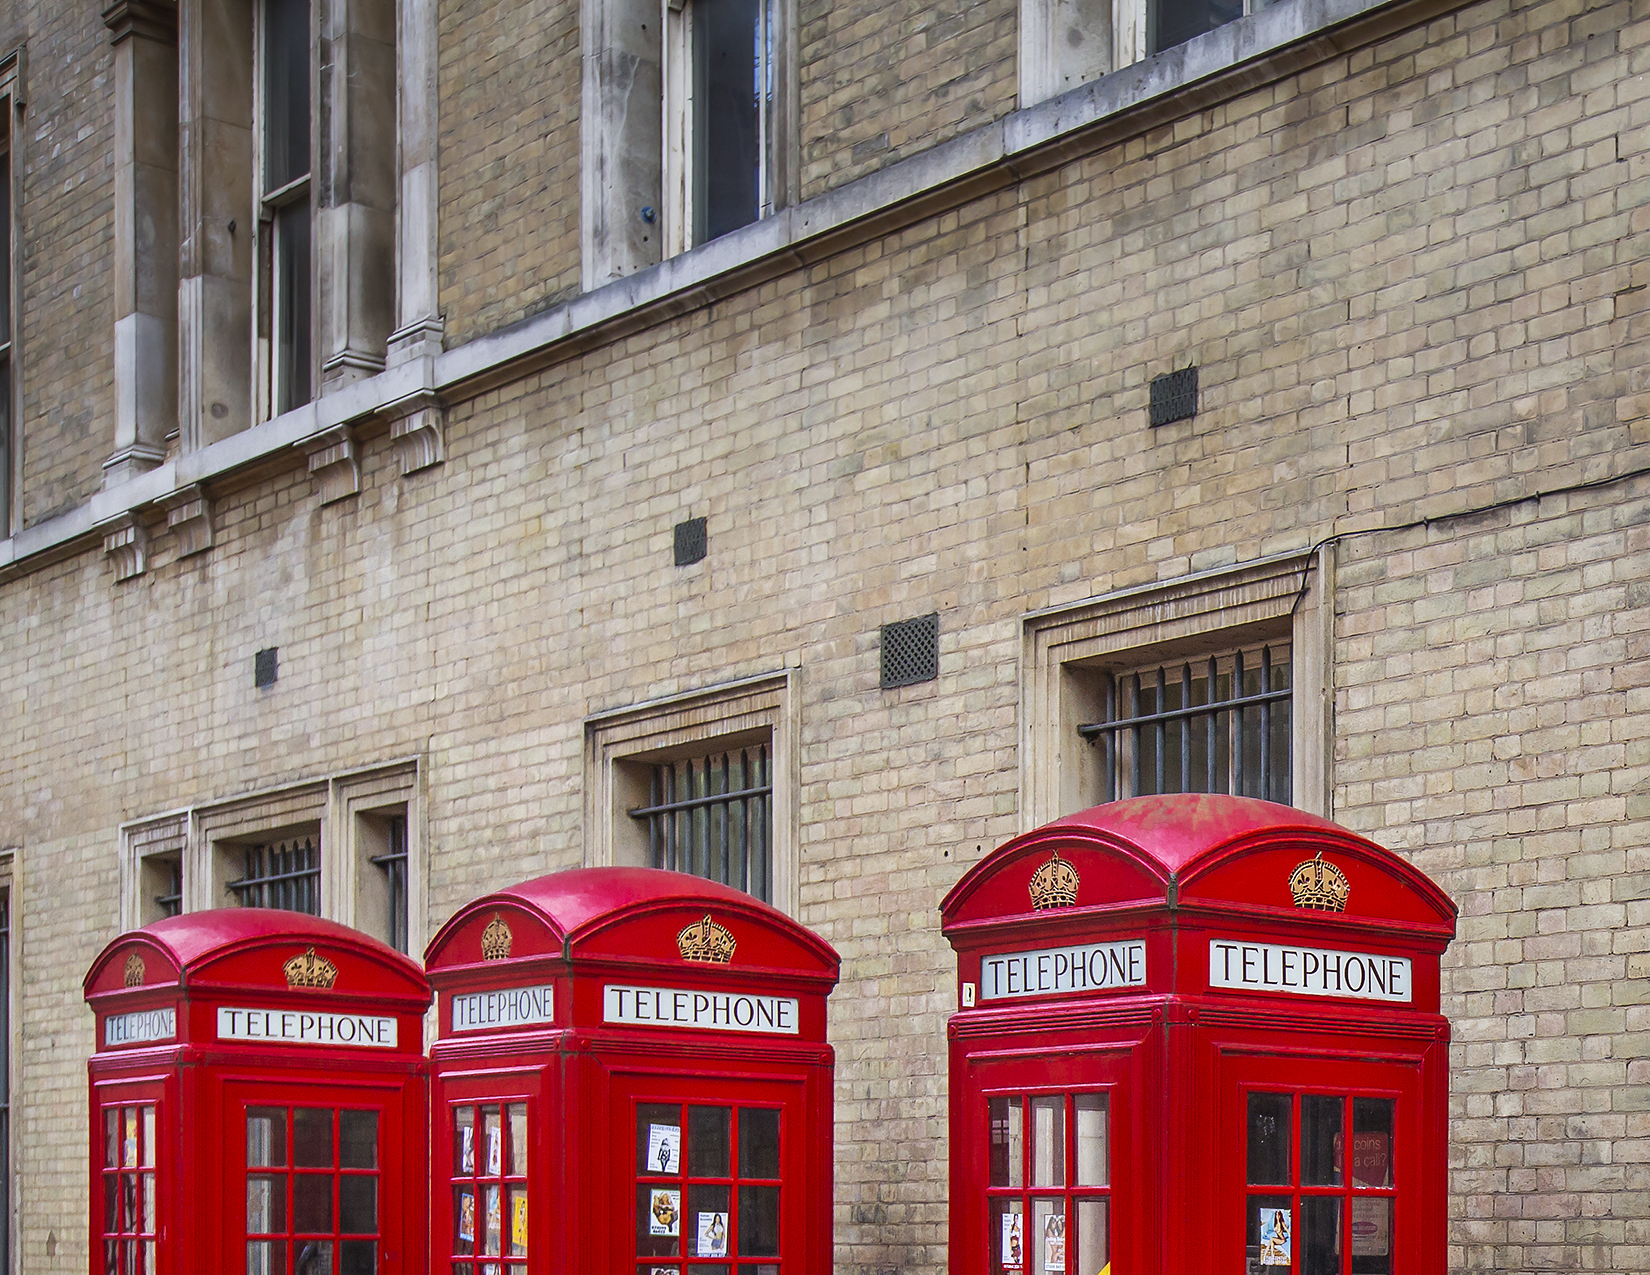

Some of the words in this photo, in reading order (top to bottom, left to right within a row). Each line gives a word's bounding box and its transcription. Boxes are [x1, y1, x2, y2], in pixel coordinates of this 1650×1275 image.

[987, 944, 1146, 995] TELEPHONE
[1215, 944, 1405, 996] TELEPHONE
[457, 987, 552, 1026] TELEPHONE
[610, 988, 793, 1029] TELEPHONE
[109, 1009, 175, 1041] TELEPHONE
[224, 1010, 391, 1043] TELEPHONE
[1354, 1139, 1381, 1150] coins
[1363, 1152, 1387, 1168] call?
